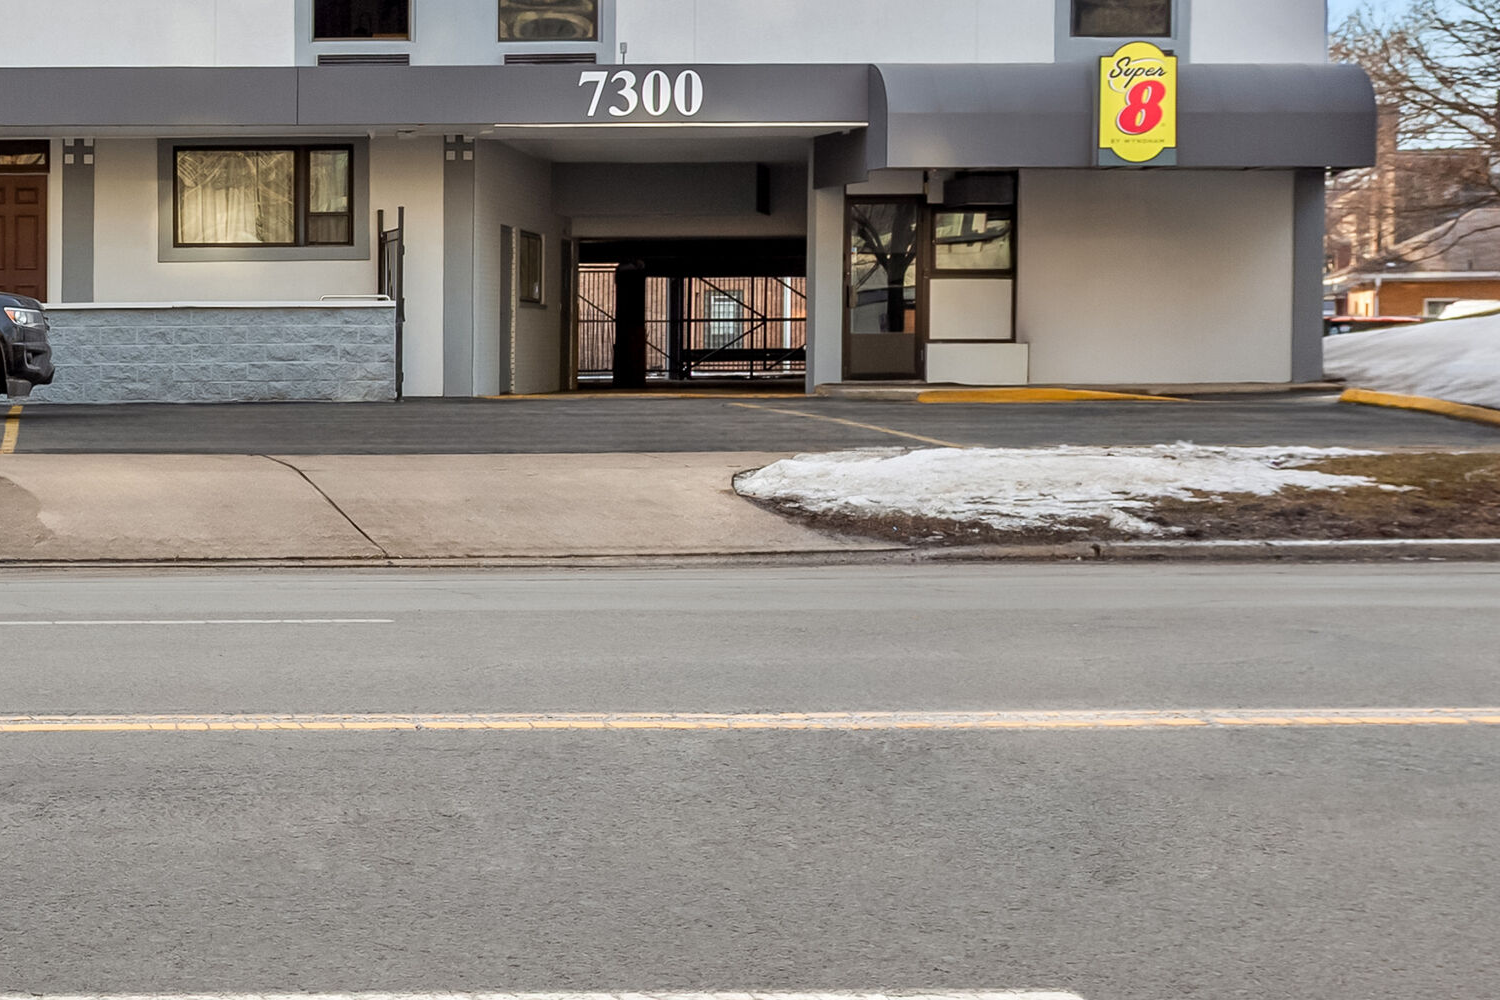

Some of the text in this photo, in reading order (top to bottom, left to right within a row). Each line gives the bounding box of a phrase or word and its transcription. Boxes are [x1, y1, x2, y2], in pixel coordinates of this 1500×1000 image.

[578, 69, 703, 117] 7300
[1109, 56, 1167, 88] Super
[1115, 80, 1166, 135] 8
